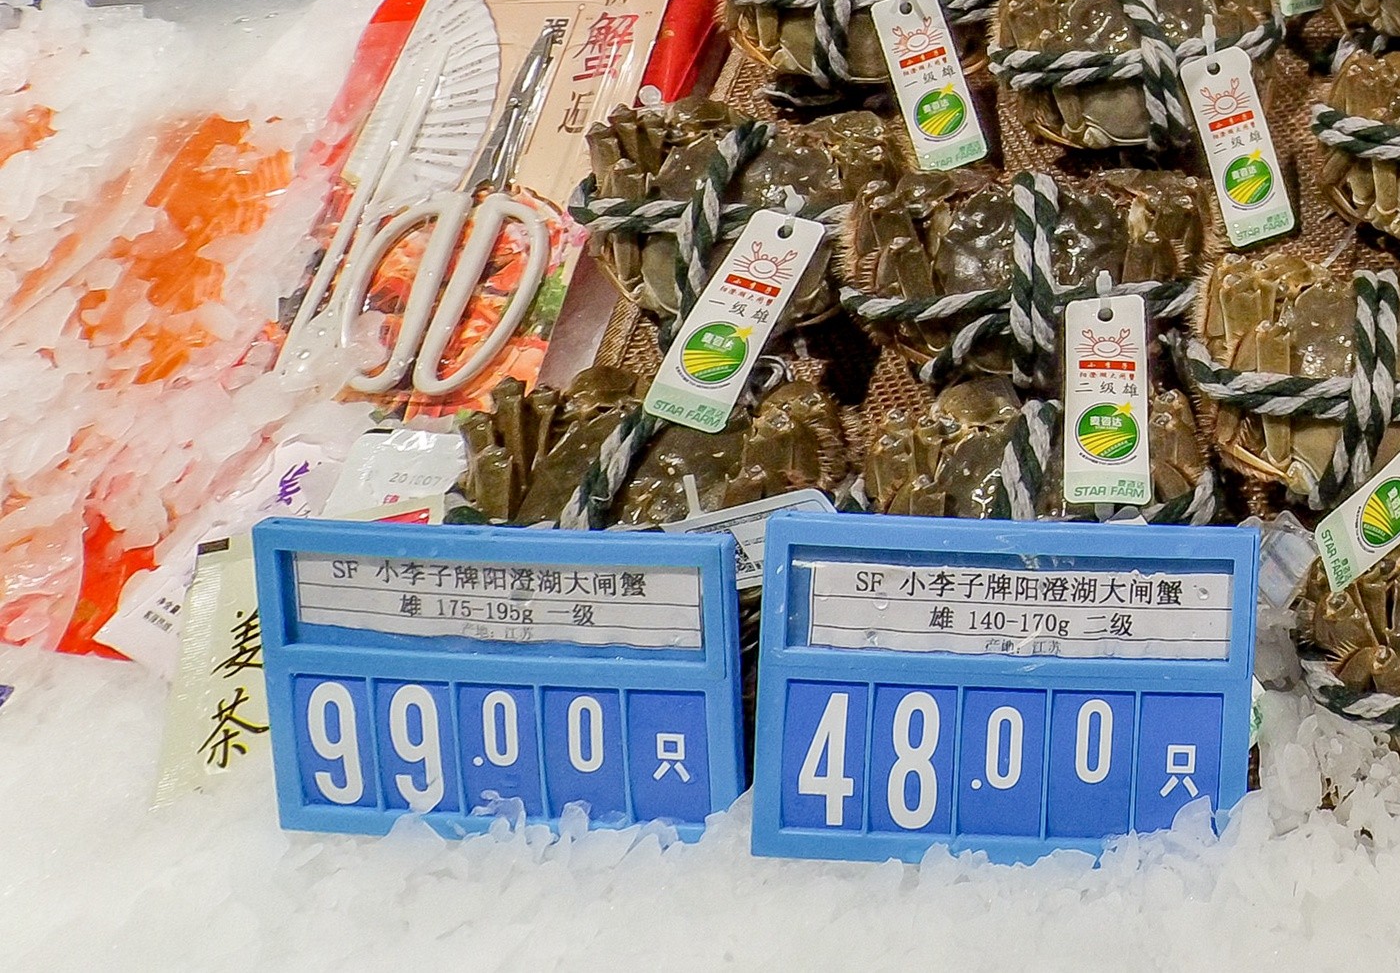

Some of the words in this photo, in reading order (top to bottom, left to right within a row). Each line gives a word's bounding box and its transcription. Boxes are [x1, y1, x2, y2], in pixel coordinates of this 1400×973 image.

[1213, 131, 1263, 155] 二级雄
[709, 300, 771, 324] 一级雄
[1075, 381, 1139, 397] 二级雄
[653, 399, 684, 415] STAR
[686, 409, 722, 428] FARM
[1074, 486, 1106, 497] STAR
[1110, 487, 1145, 499] FARM
[333, 560, 359, 580] SF
[376, 564, 647, 597] 小李子牌阳澄湖大闸蟹
[855, 571, 884, 592] SF
[899, 571, 1183, 607] 小李子牌阳澄湖大闸蟹
[437, 599, 534, 624] 175-195g
[547, 604, 596, 626] 一级
[929, 606, 954, 629] 雄
[969, 610, 1071, 637] 140-170g
[1083, 614, 1134, 637] 二级
[307, 681, 604, 813] 99.00
[652, 732, 692, 783] 只
[798, 691, 1114, 830] 48.00
[1160, 743, 1199, 798] 只
